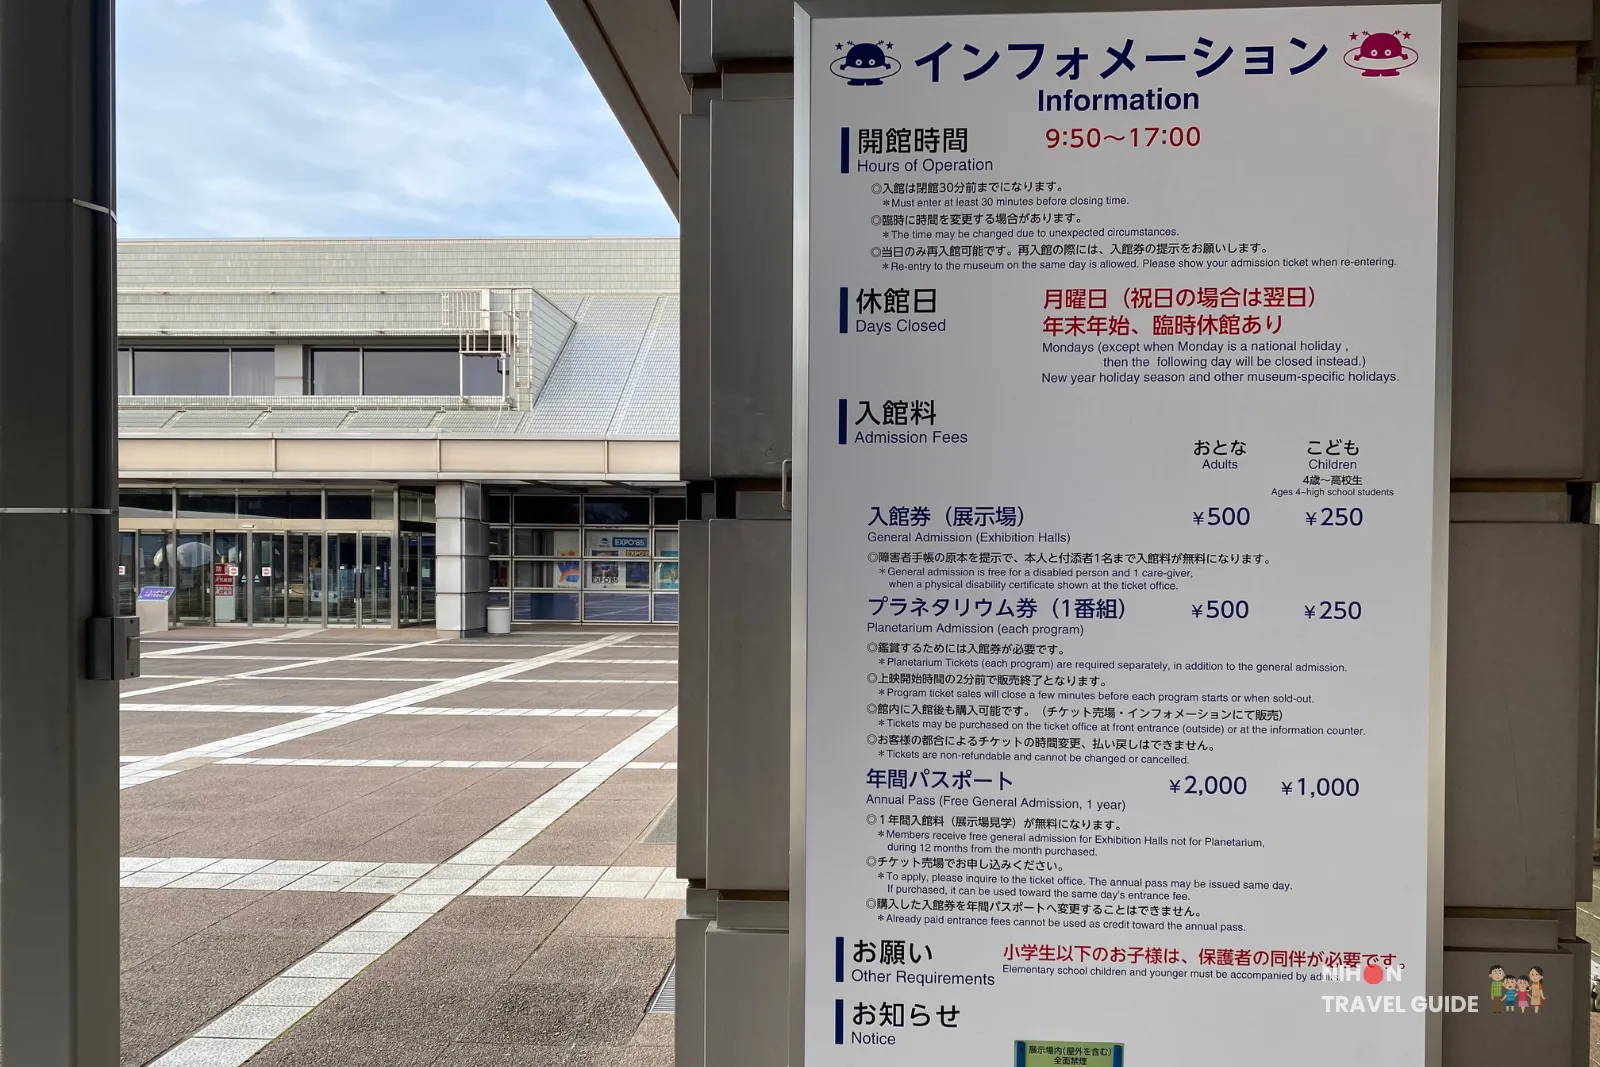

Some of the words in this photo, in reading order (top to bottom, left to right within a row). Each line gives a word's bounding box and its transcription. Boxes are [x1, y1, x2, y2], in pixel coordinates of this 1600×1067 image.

[914, 36, 1328, 82] インフォメーション
[1038, 87, 1198, 111] Information
[858, 126, 967, 154] 開館時間
[857, 159, 899, 172] Hours
[904, 158, 918, 171] of
[922, 157, 992, 174] Operation
[882, 180, 1061, 194] 入館は閉館30分前までになります。
[891, 198, 914, 207] Must
[917, 198, 941, 207] enter
[944, 198, 953, 206] at
[956, 197, 978, 206] least
[981, 197, 993, 206] 30
[996, 197, 1033, 206] minutes
[1036, 196, 1066, 205] before
[1069, 196, 1103, 207] closing
[1105, 195, 1129, 204] time.
[882, 212, 1080, 226] 臨時に時間を変更する場合があります。
[891, 230, 909, 239] The
[912, 229, 932, 238] time
[935, 231, 955, 240] may
[958, 229, 969, 238] be
[972, 228, 1013, 240] changed
[1016, 228, 1034, 237] due
[1037, 228, 1046, 237] to
[1049, 227, 1104, 238] unexpected
[1107, 227, 1179, 236] circumstances.
[856, 287, 936, 314] 休館日
[856, 319, 891, 335] Days
[896, 318, 945, 332] Closed
[1042, 313, 1281, 336] 年末年始、臨時休館あり
[1042, 342, 1094, 354] Mondays
[1097, 341, 1140, 354] (except
[1143, 341, 1173, 351] when
[1178, 340, 1224, 353] Monday
[1227, 340, 1236, 351] is
[1240, 343, 1247, 351] a
[1251, 340, 1296, 351] national
[1103, 356, 1128, 367] then
[1131, 356, 1149, 367] the
[1157, 356, 1207, 369] following
[1210, 356, 1232, 369] day
[1235, 356, 1253, 366] will
[1257, 356, 1271, 366] be
[1274, 355, 1312, 366] closed
[1316, 355, 1365, 368] instead.)
[854, 399, 936, 425] 入館料
[854, 430, 927, 443] Admission
[932, 430, 967, 443] Fees
[1193, 439, 1246, 455] おとな
[1307, 439, 1359, 456] こども
[1201, 459, 1238, 469] Adults
[1308, 458, 1356, 469] Children
[1270, 487, 1293, 497] Ages
[1357, 488, 1394, 496] students
[1193, 507, 1250, 525] ¥500
[1305, 507, 1363, 526] ¥250
[867, 531, 911, 542] General
[914, 531, 972, 542] Admission
[975, 531, 1034, 544] (Exhibition
[1038, 532, 1070, 544] Halls)
[888, 579, 913, 588] when
[924, 579, 962, 590] physical
[965, 579, 1006, 591] disability
[1008, 580, 1054, 589] certificate
[1057, 580, 1088, 589] shown
[1091, 581, 1100, 589] at
[1103, 580, 1118, 589] the
[1121, 580, 1146, 589] ticket
[1149, 580, 1178, 590] office.
[1191, 600, 1248, 618] ¥500
[1304, 600, 1361, 619] ¥250
[867, 622, 932, 632] Planetarium
[935, 622, 993, 633] Admission
[997, 623, 1028, 636] (each
[1032, 624, 1083, 637] program)
[877, 642, 1063, 655] 鑑賞するためには入館券が必要です。
[886, 750, 919, 758] Tickets
[922, 751, 937, 759] are
[940, 751, 1011, 760] non-refundable
[1013, 752, 1031, 761] and
[1034, 753, 1066, 761] cannot
[1069, 753, 1081, 762] be
[1084, 753, 1125, 764] changed
[1140, 755, 1189, 764] cancelled.
[866, 767, 1012, 790] 年間パスポート
[1169, 775, 1246, 796] ¥2,000
[1281, 777, 1359, 798] ¥1,000
[865, 793, 904, 804] Annual
[908, 794, 935, 805] Pass
[939, 795, 968, 807] (Free
[972, 796, 1016, 807] General
[1020, 797, 1082, 810] Admission,
[1086, 799, 1091, 809] 1
[1096, 799, 1125, 812] year)
[877, 856, 1062, 871] チケット売場でお申し込みください。
[886, 913, 921, 925] Already
[924, 915, 944, 925] paid
[946, 916, 987, 925] entrance
[990, 916, 1010, 925] fees
[1013, 918, 1045, 926] cannot
[1048, 918, 1060, 927] be
[1062, 919, 1086, 927] used
[1088, 920, 1100, 928] as
[1102, 920, 1129, 928] credit
[1132, 920, 1164, 929] toward
[1167, 921, 1182, 930] the
[1185, 922, 1217, 930] annual
[1220, 924, 1245, 932] pass.
[852, 939, 932, 965] お願い
[851, 969, 891, 982] Other
[896, 970, 994, 986] Requirements
[1003, 965, 1054, 976] Elementary
[1058, 966, 1088, 975] school
[1091, 967, 1126, 976] children
[1129, 967, 1146, 976] and
[1149, 970, 1187, 979] younger
[1190, 970, 1213, 978] must
[1215, 969, 1227, 978] be
[1230, 971, 1293, 981] accompanied
[1296, 971, 1307, 982] by
[852, 1001, 960, 1027] お知らせ
[851, 1031, 895, 1045] Notice
[1053, 1056, 1088, 1066] 全面禁煙
